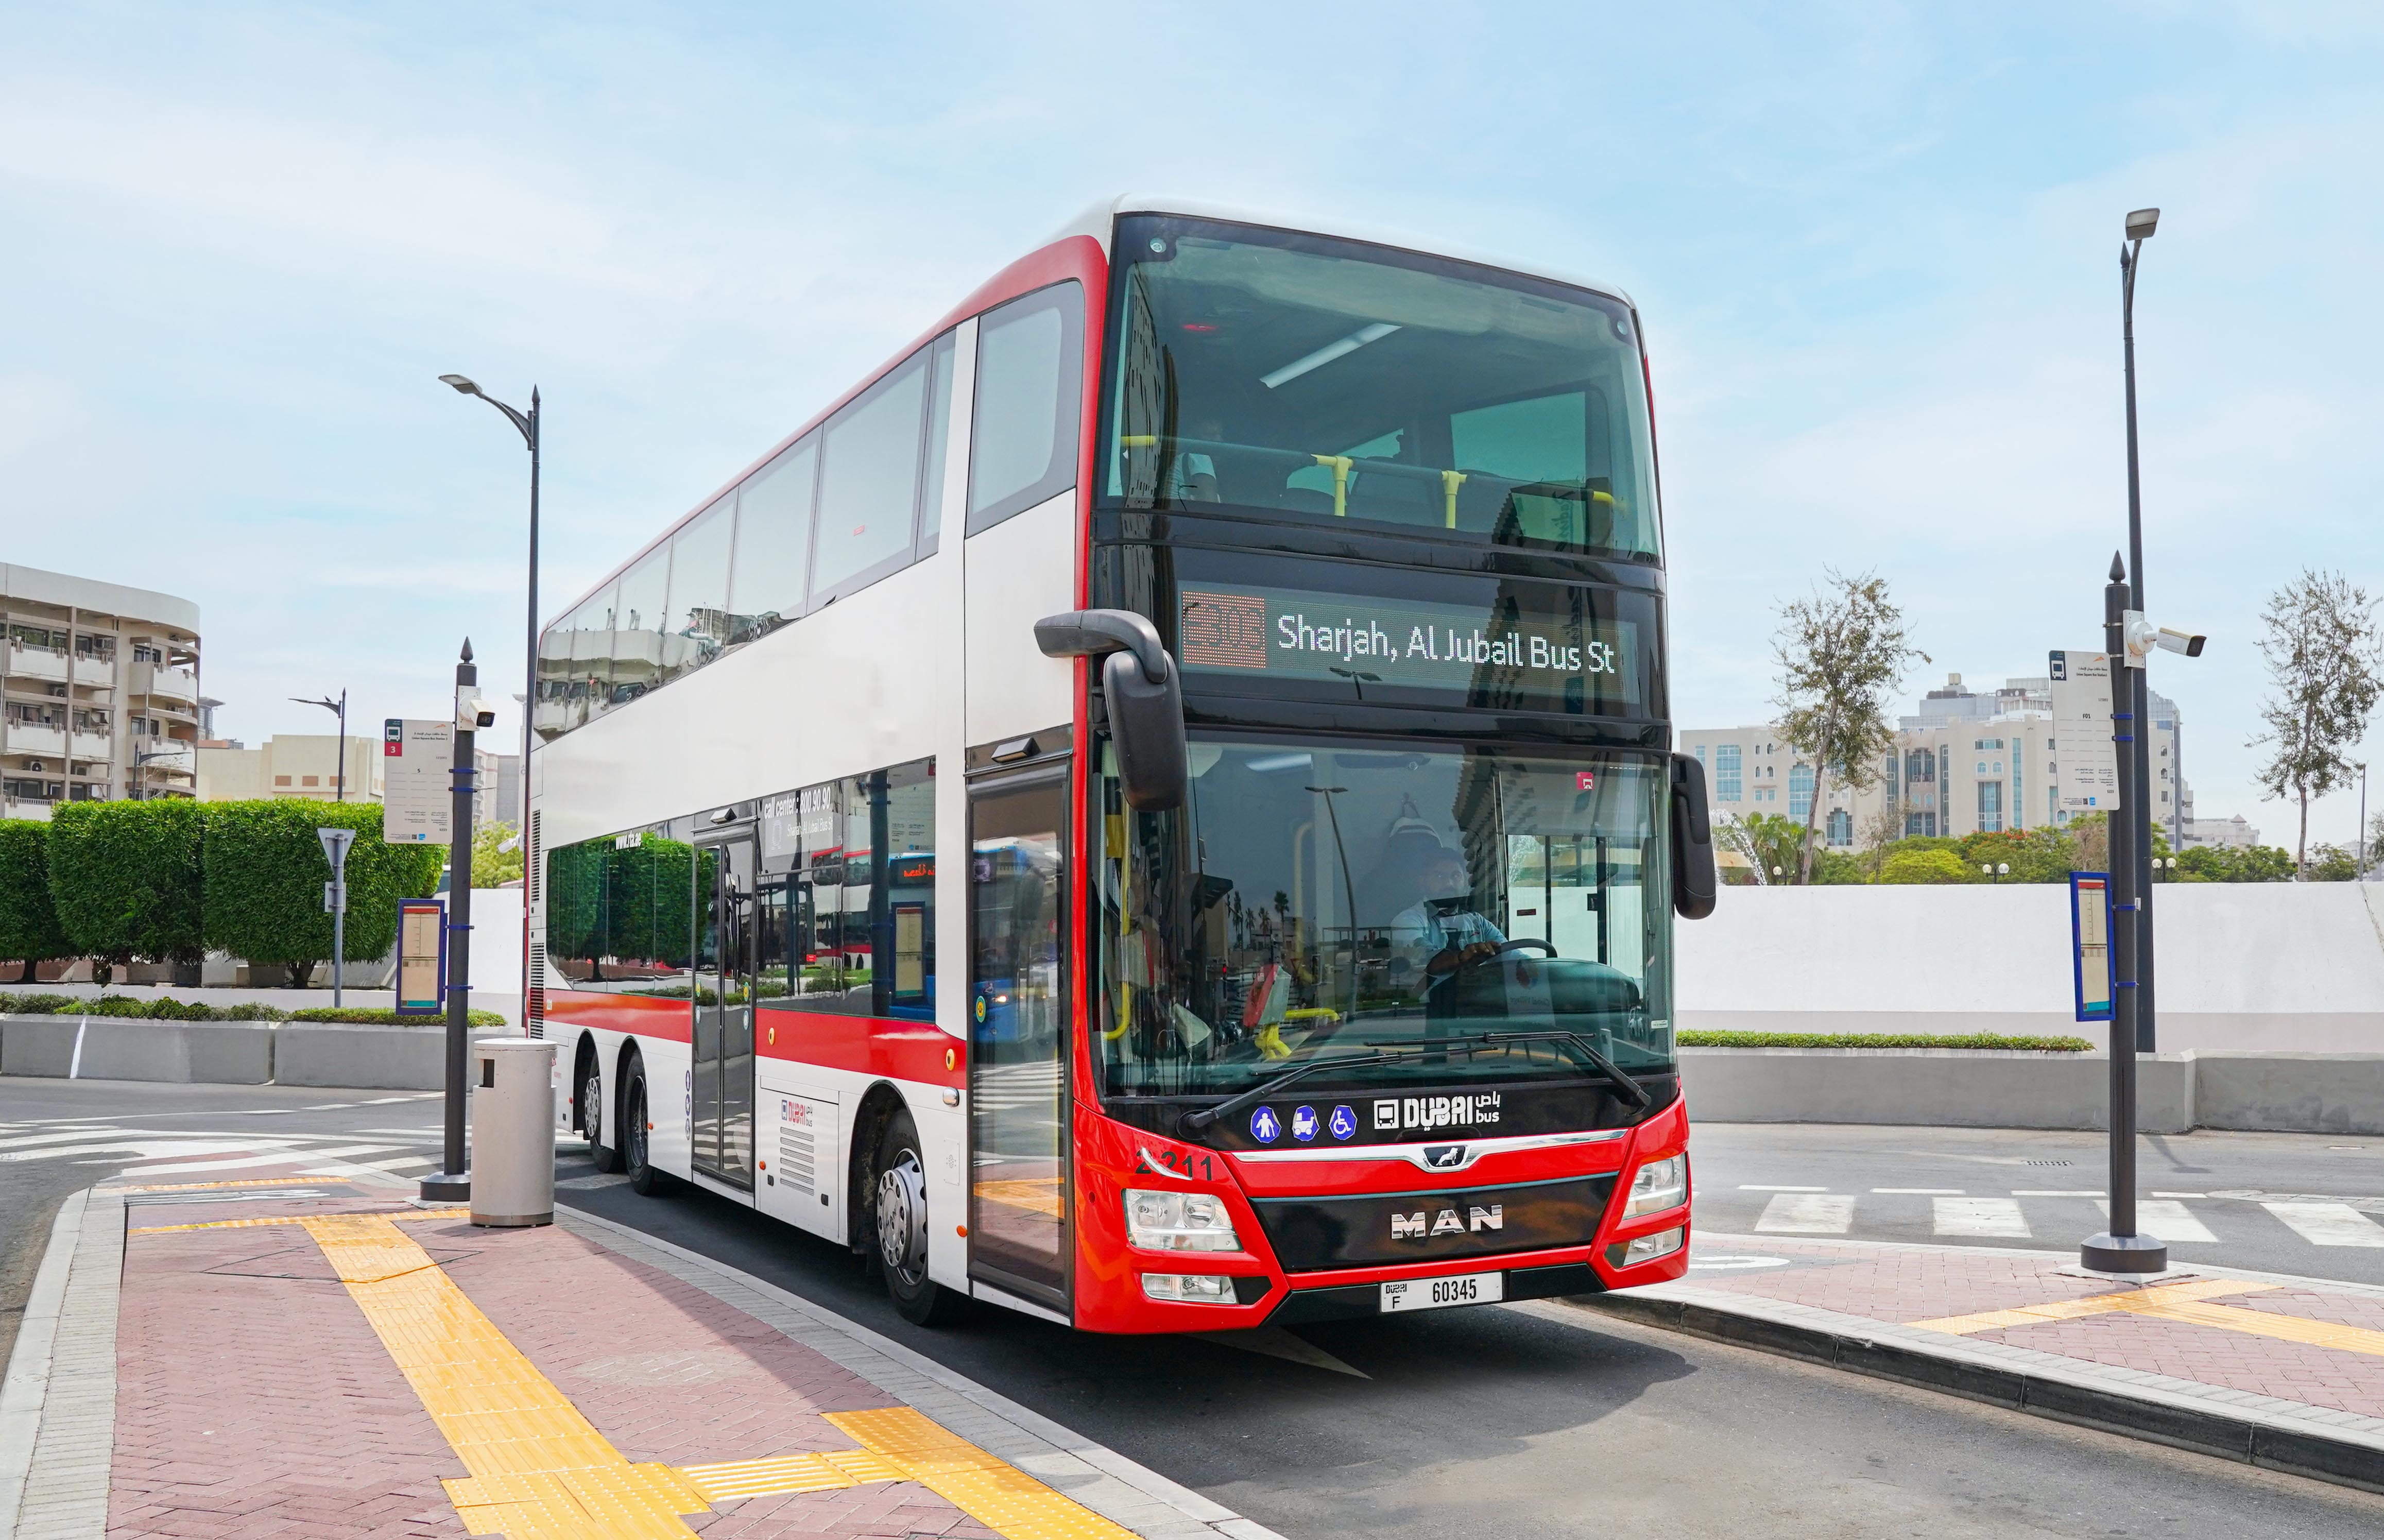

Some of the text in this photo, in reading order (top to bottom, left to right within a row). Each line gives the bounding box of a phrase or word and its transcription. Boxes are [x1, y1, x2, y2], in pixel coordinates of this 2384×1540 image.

[1278, 614, 1615, 674] Sharjah, Al Jubail Bus St
[764, 796, 775, 819] call
[776, 794, 796, 817] center
[800, 791, 812, 815] 800
[813, 788, 821, 812] 90
[822, 786, 831, 810] 90
[615, 830, 642, 850] www.rta.ae
[1475, 1091, 1500, 1108] باص
[1404, 1096, 1473, 1131] DUBAI
[1476, 1109, 1500, 1124] bus
[1391, 1204, 1503, 1239] MAN
[1393, 1296, 1400, 1309] F
[1433, 1279, 1477, 1303] 60345
